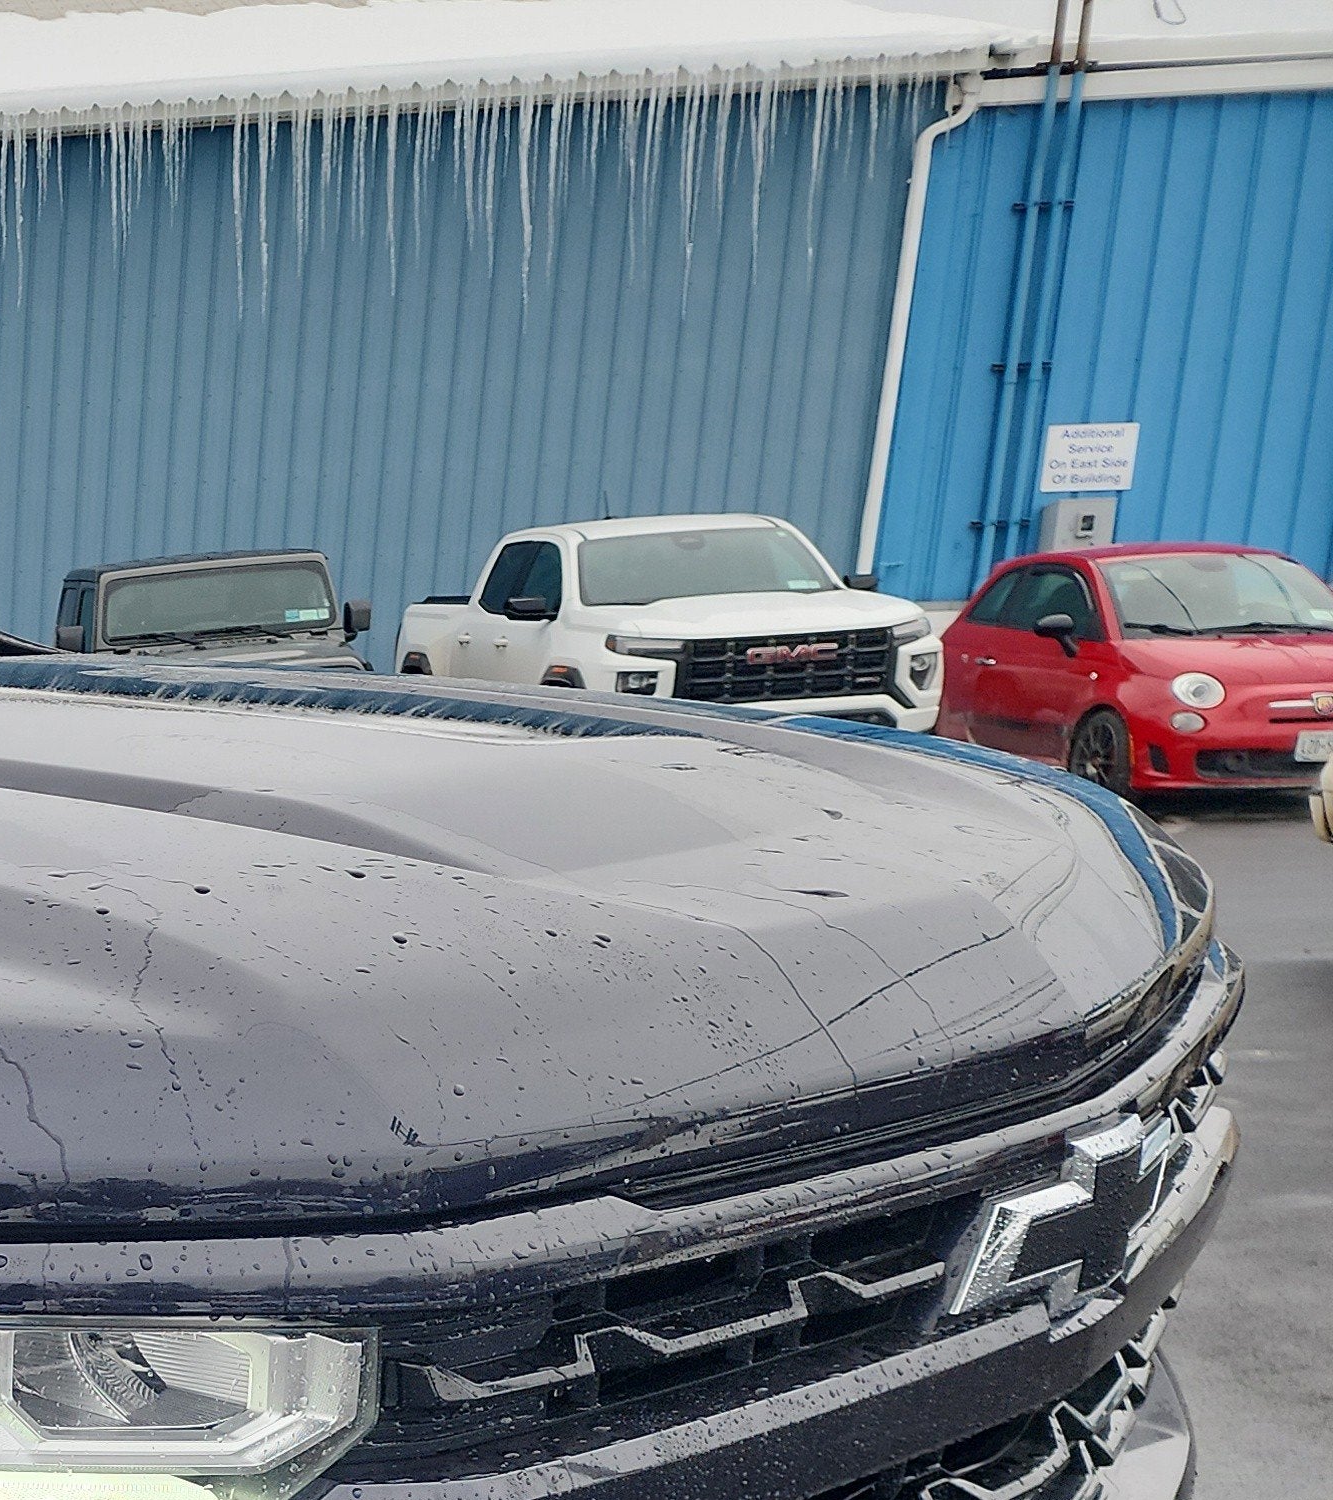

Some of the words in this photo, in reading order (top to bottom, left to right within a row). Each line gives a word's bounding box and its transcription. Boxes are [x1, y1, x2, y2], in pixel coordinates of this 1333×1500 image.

[1062, 427, 1125, 439] Additional
[1068, 443, 1114, 454] Service
[1049, 459, 1067, 470] On
[1071, 458, 1098, 469] East
[1101, 457, 1128, 468] Side
[1070, 473, 1121, 485] Building
[745, 642, 840, 666] GMC
